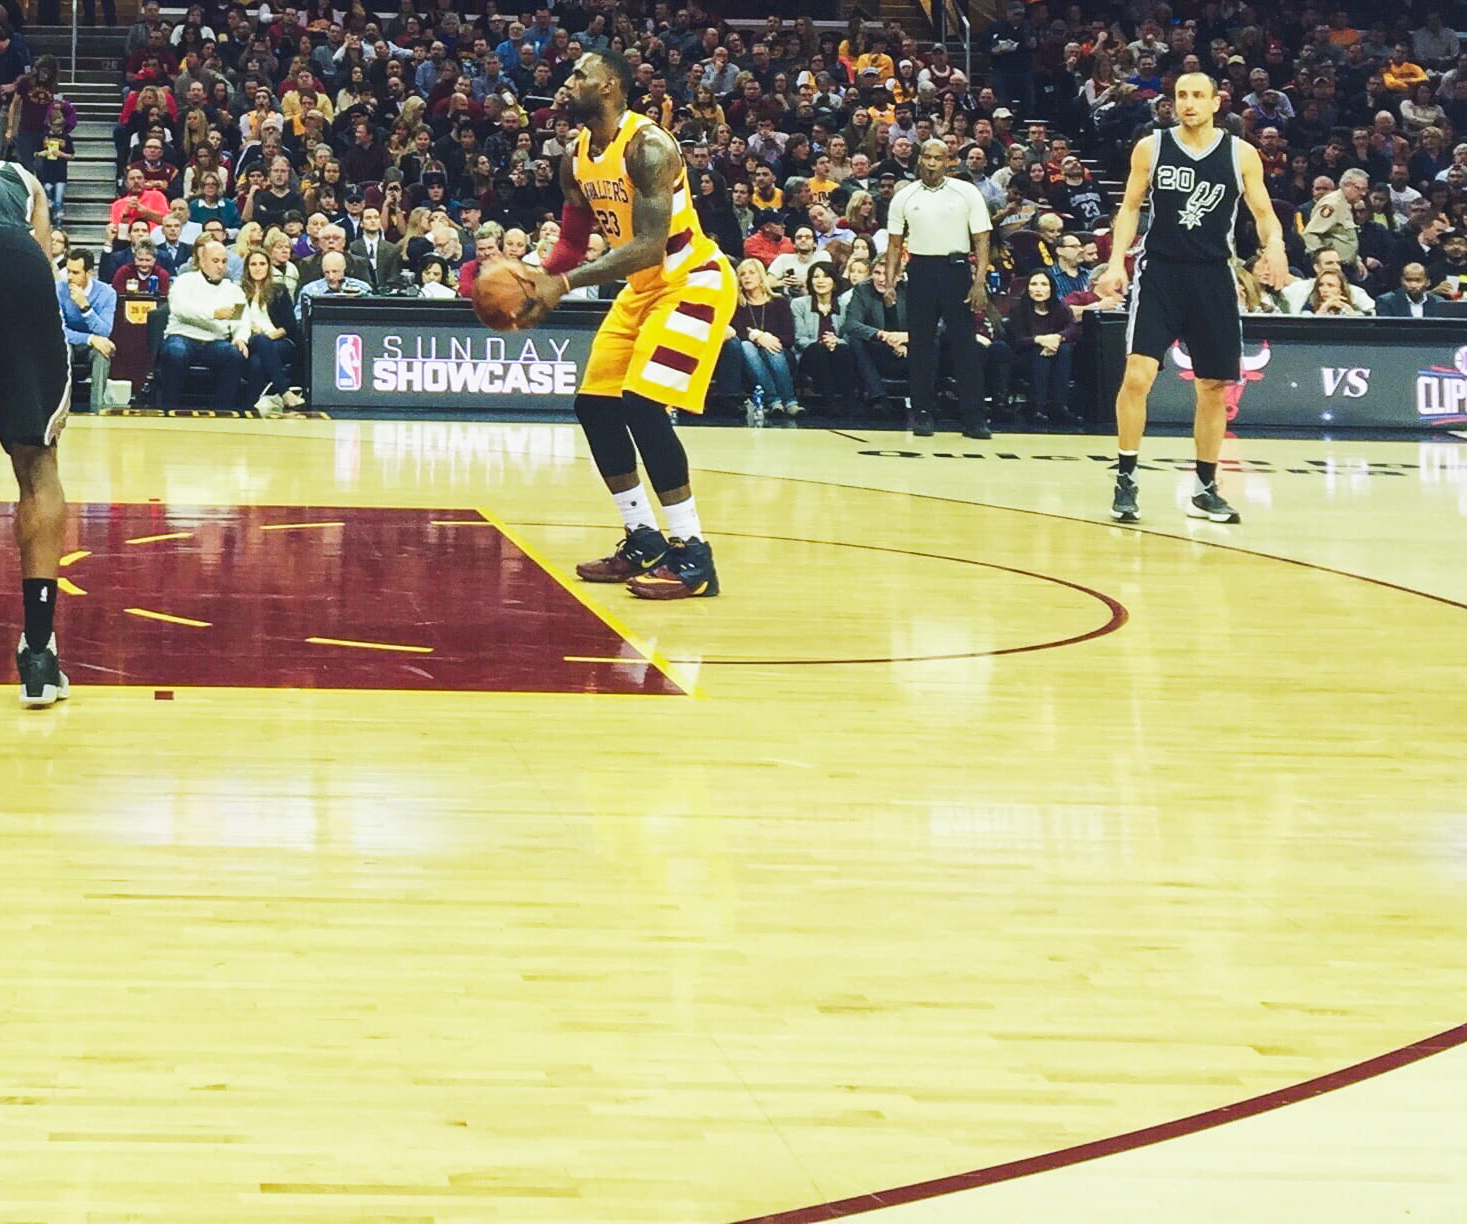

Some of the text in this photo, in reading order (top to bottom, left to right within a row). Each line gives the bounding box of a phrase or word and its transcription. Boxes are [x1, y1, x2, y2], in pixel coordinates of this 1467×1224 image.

[1156, 164, 1195, 192] 20
[596, 209, 622, 238] 23
[383, 335, 571, 362] SUNDAY
[372, 361, 578, 396] SHOWCASE
[1319, 366, 1371, 398] VS
